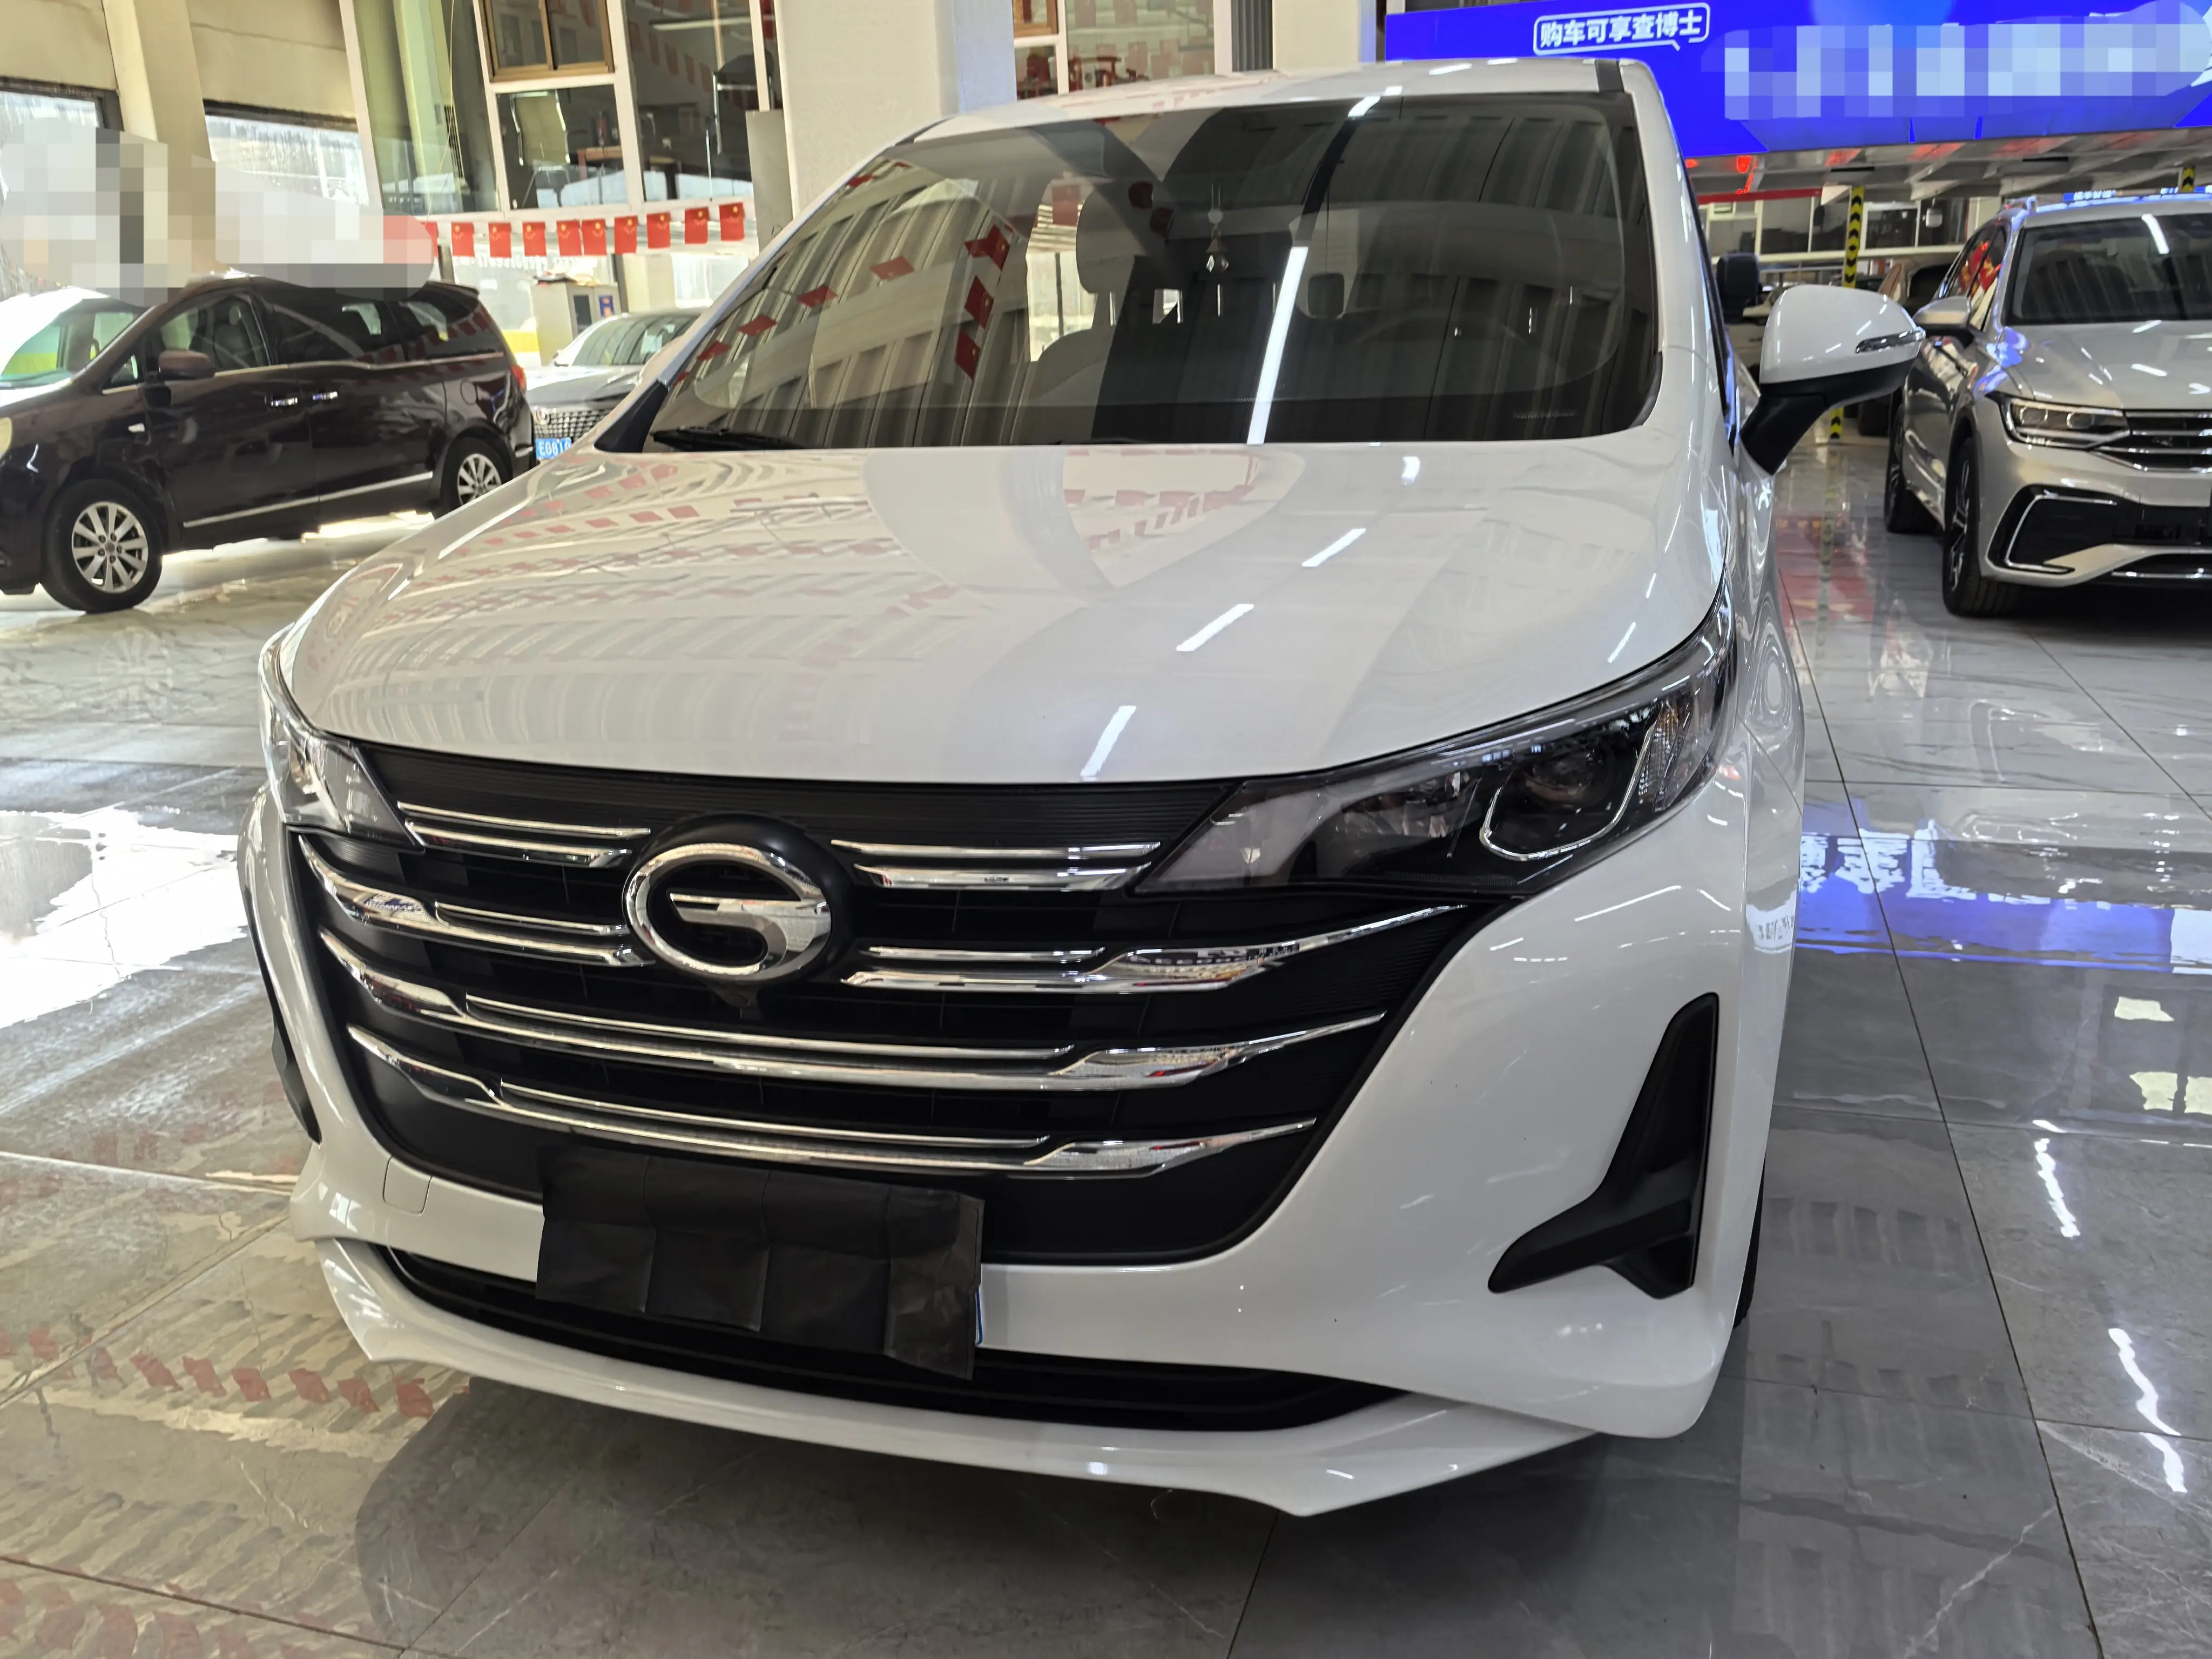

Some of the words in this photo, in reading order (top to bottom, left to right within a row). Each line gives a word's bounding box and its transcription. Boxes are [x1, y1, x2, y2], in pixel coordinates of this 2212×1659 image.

[1540, 9, 1703, 48] 购车可享查博士
